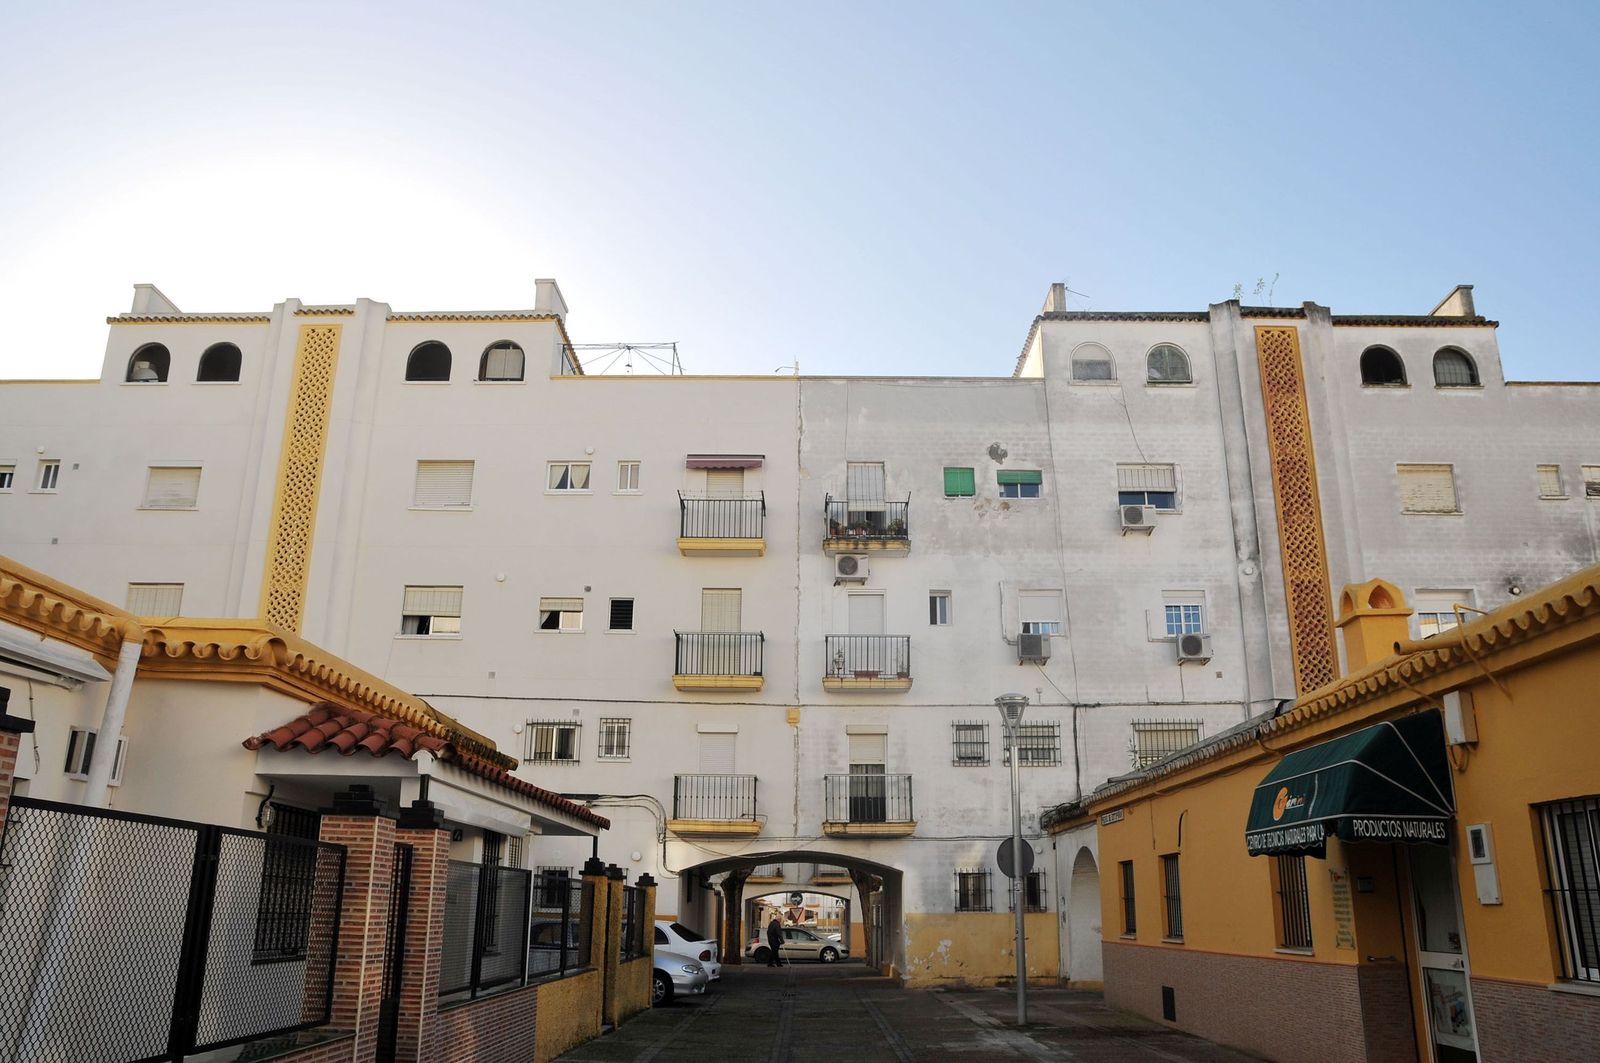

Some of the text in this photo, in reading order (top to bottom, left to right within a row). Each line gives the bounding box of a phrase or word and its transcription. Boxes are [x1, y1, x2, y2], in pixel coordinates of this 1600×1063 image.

[1247, 834, 1262, 850] CENTRO
[1285, 826, 1306, 845] NATURALES
[1353, 819, 1446, 839] PRODUCTOS NATURALES
